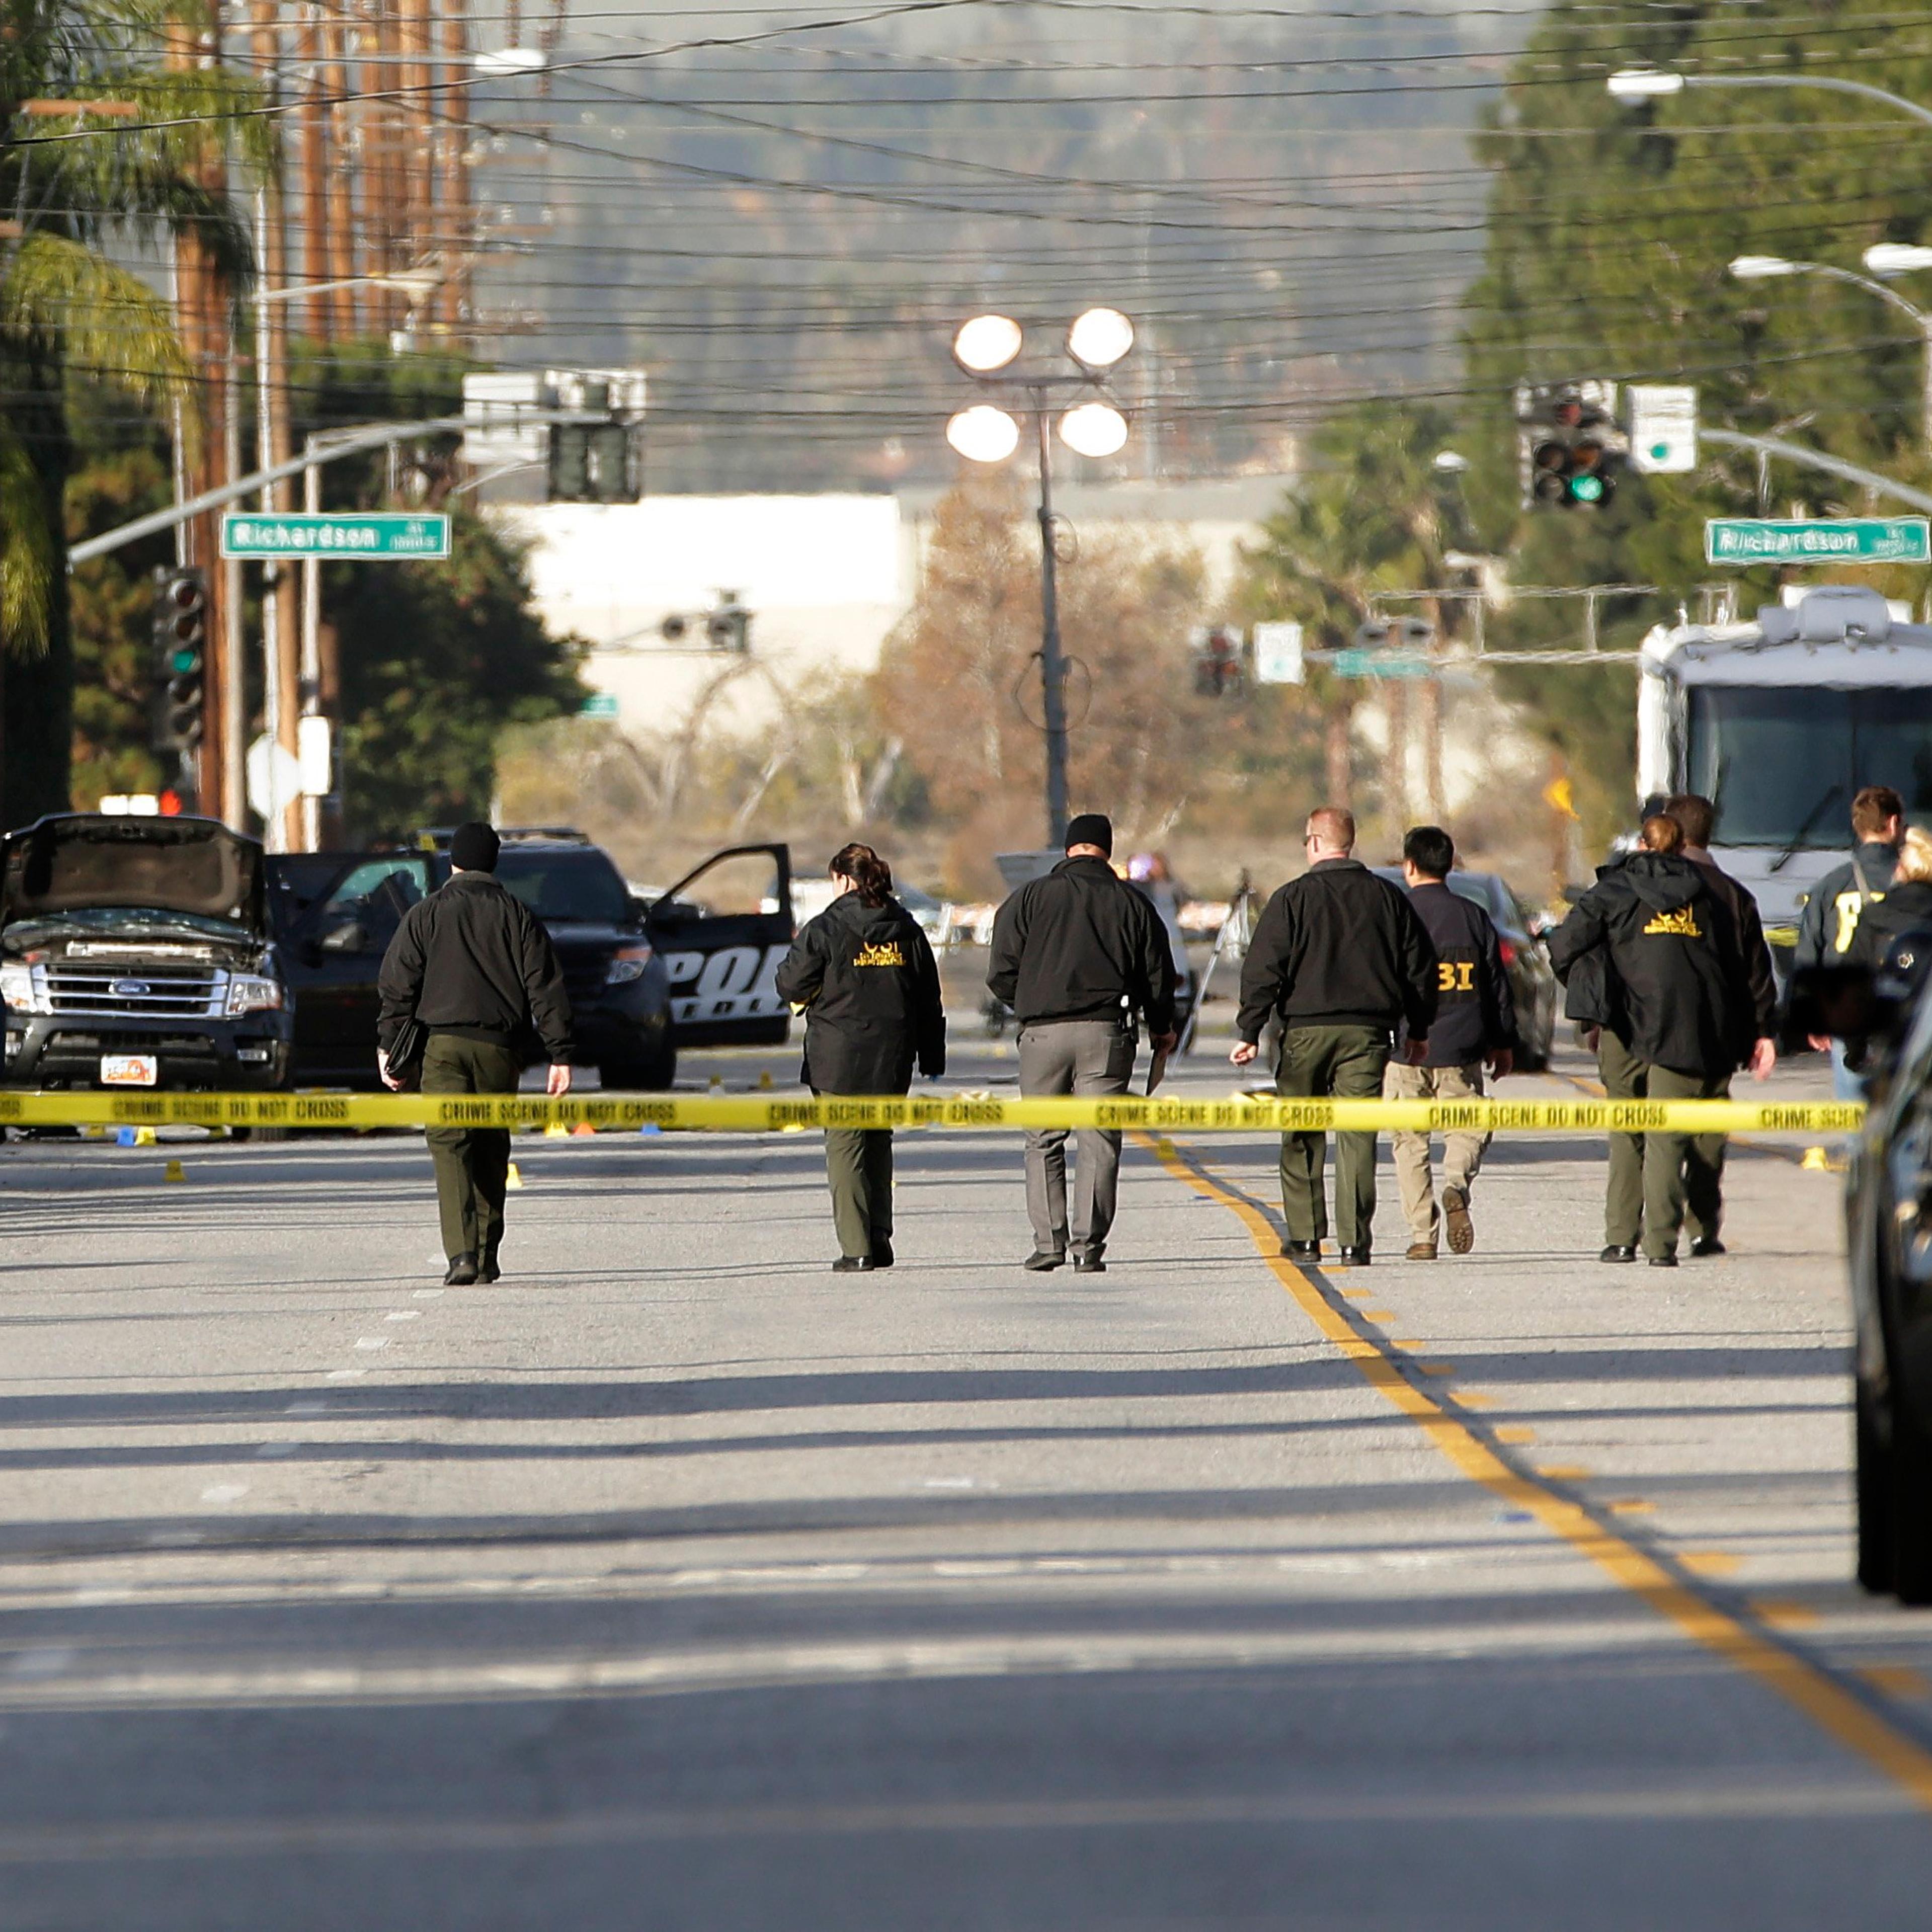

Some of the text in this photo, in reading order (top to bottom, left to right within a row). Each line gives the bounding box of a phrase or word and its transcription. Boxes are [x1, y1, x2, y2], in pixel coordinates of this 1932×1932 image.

[233, 522, 377, 548] Richardson
[1719, 528, 1859, 553] Richardson
[1438, 962, 1474, 991] BI
[1279, 1105, 1334, 1127] CROSS
[1429, 1105, 1668, 1128] CRIME SCENE DO NOT CROSS
[1760, 1108, 1812, 1130] CRIME
